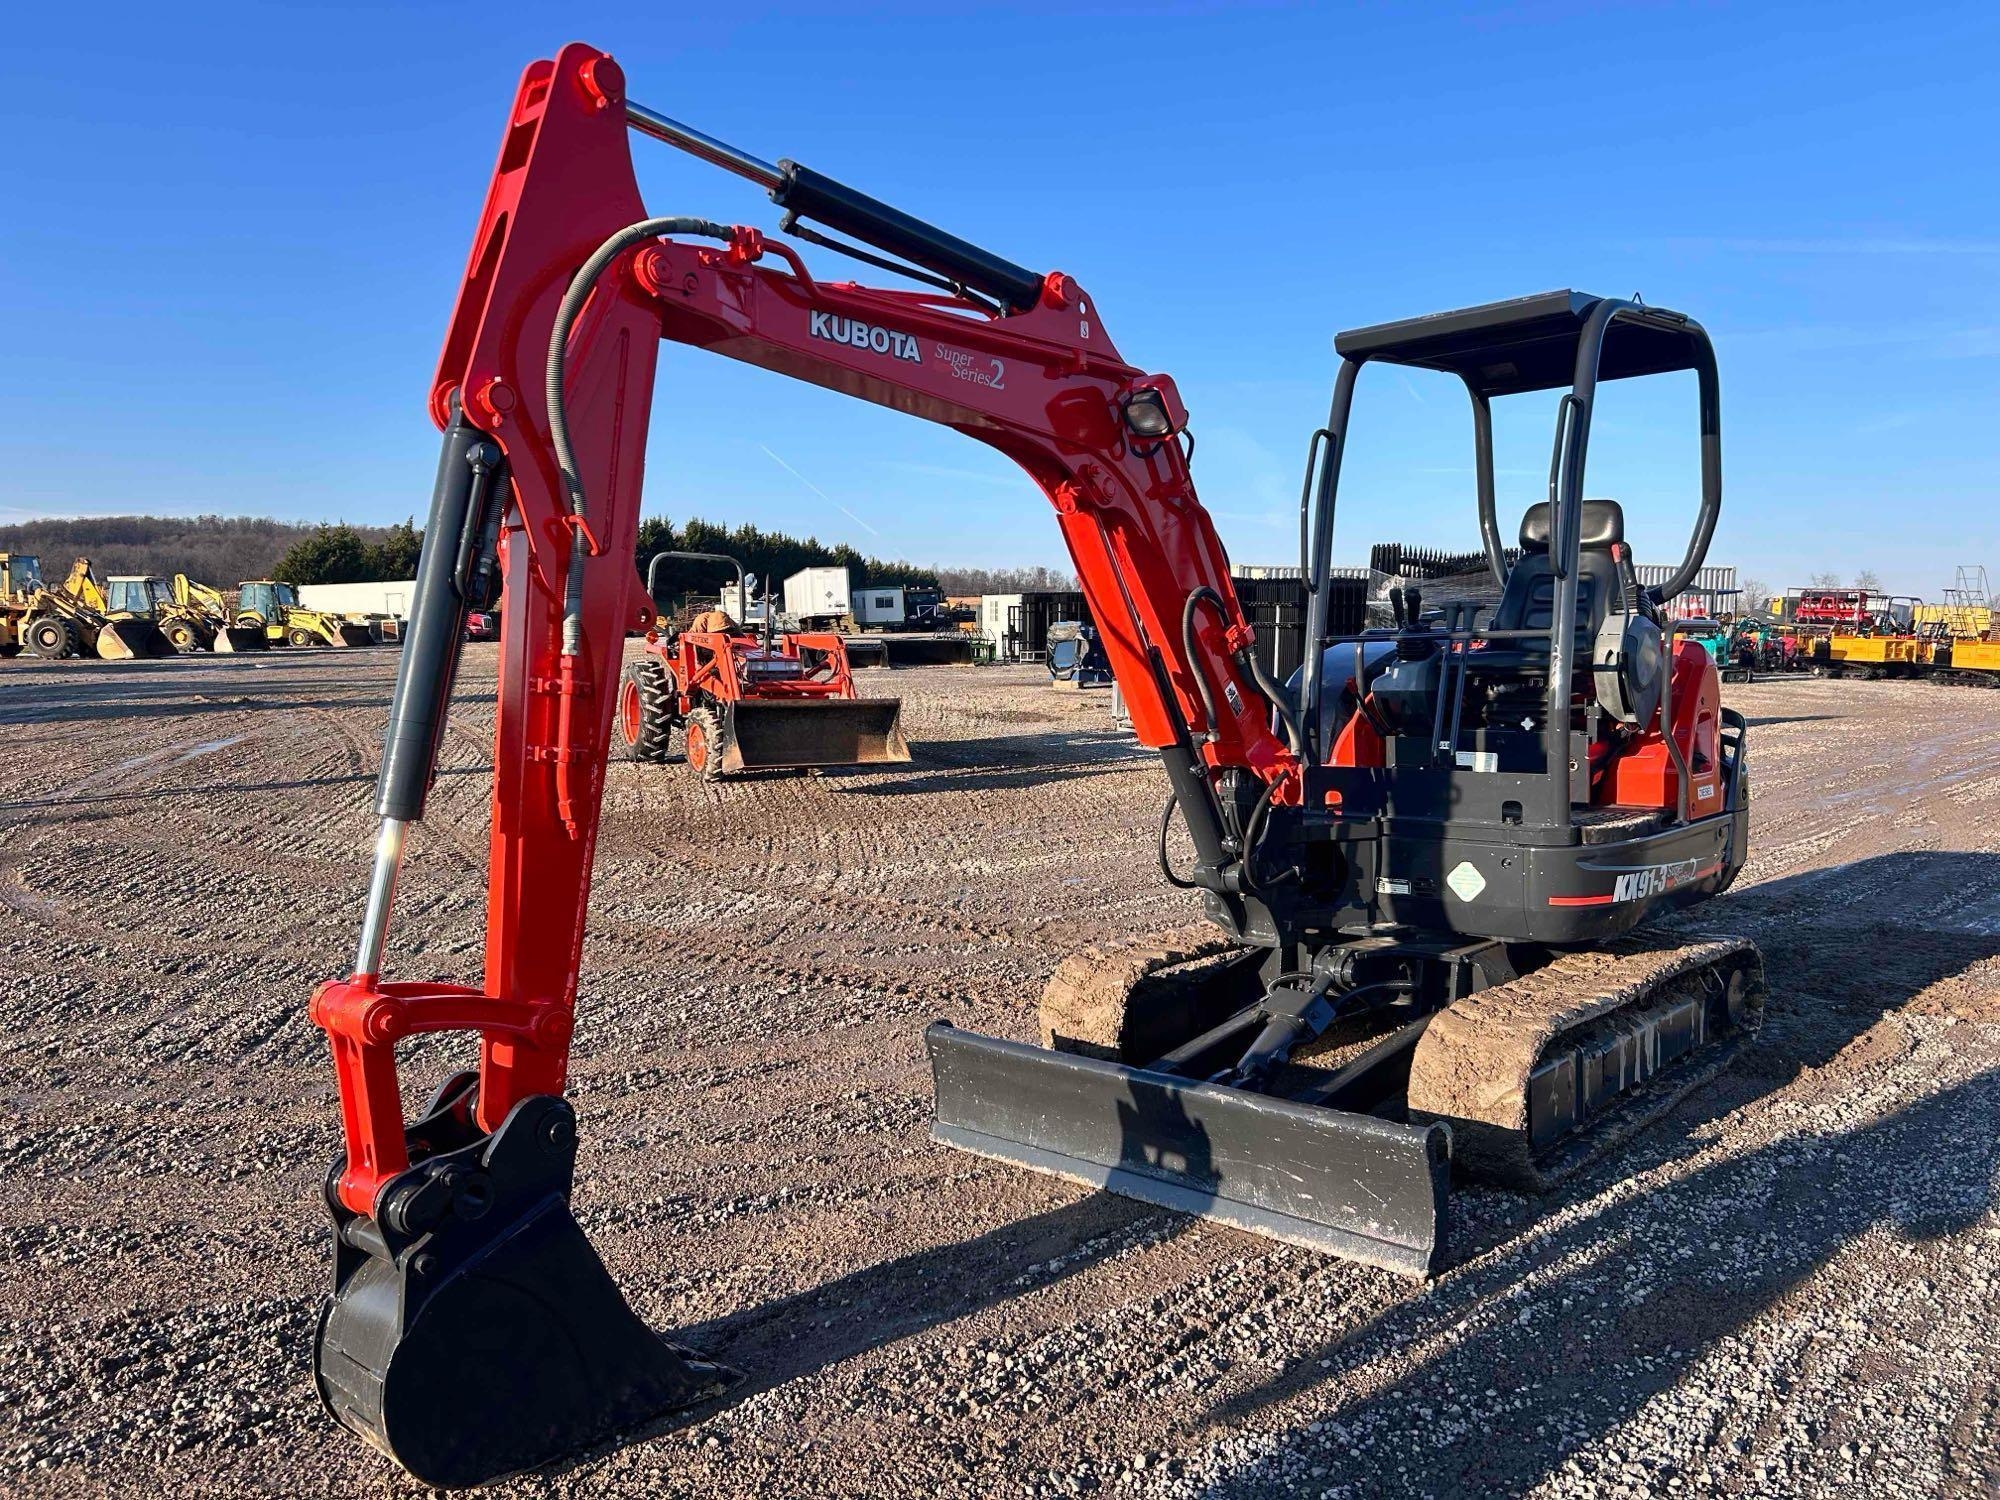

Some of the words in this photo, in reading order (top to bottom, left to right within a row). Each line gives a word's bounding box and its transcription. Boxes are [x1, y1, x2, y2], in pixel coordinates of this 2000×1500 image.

[810, 309, 922, 363] KUBOTA
[935, 342, 974, 367] Super
[951, 362, 990, 386] Series
[990, 359, 1005, 390] 2
[1612, 865, 1668, 903] KX91-3
